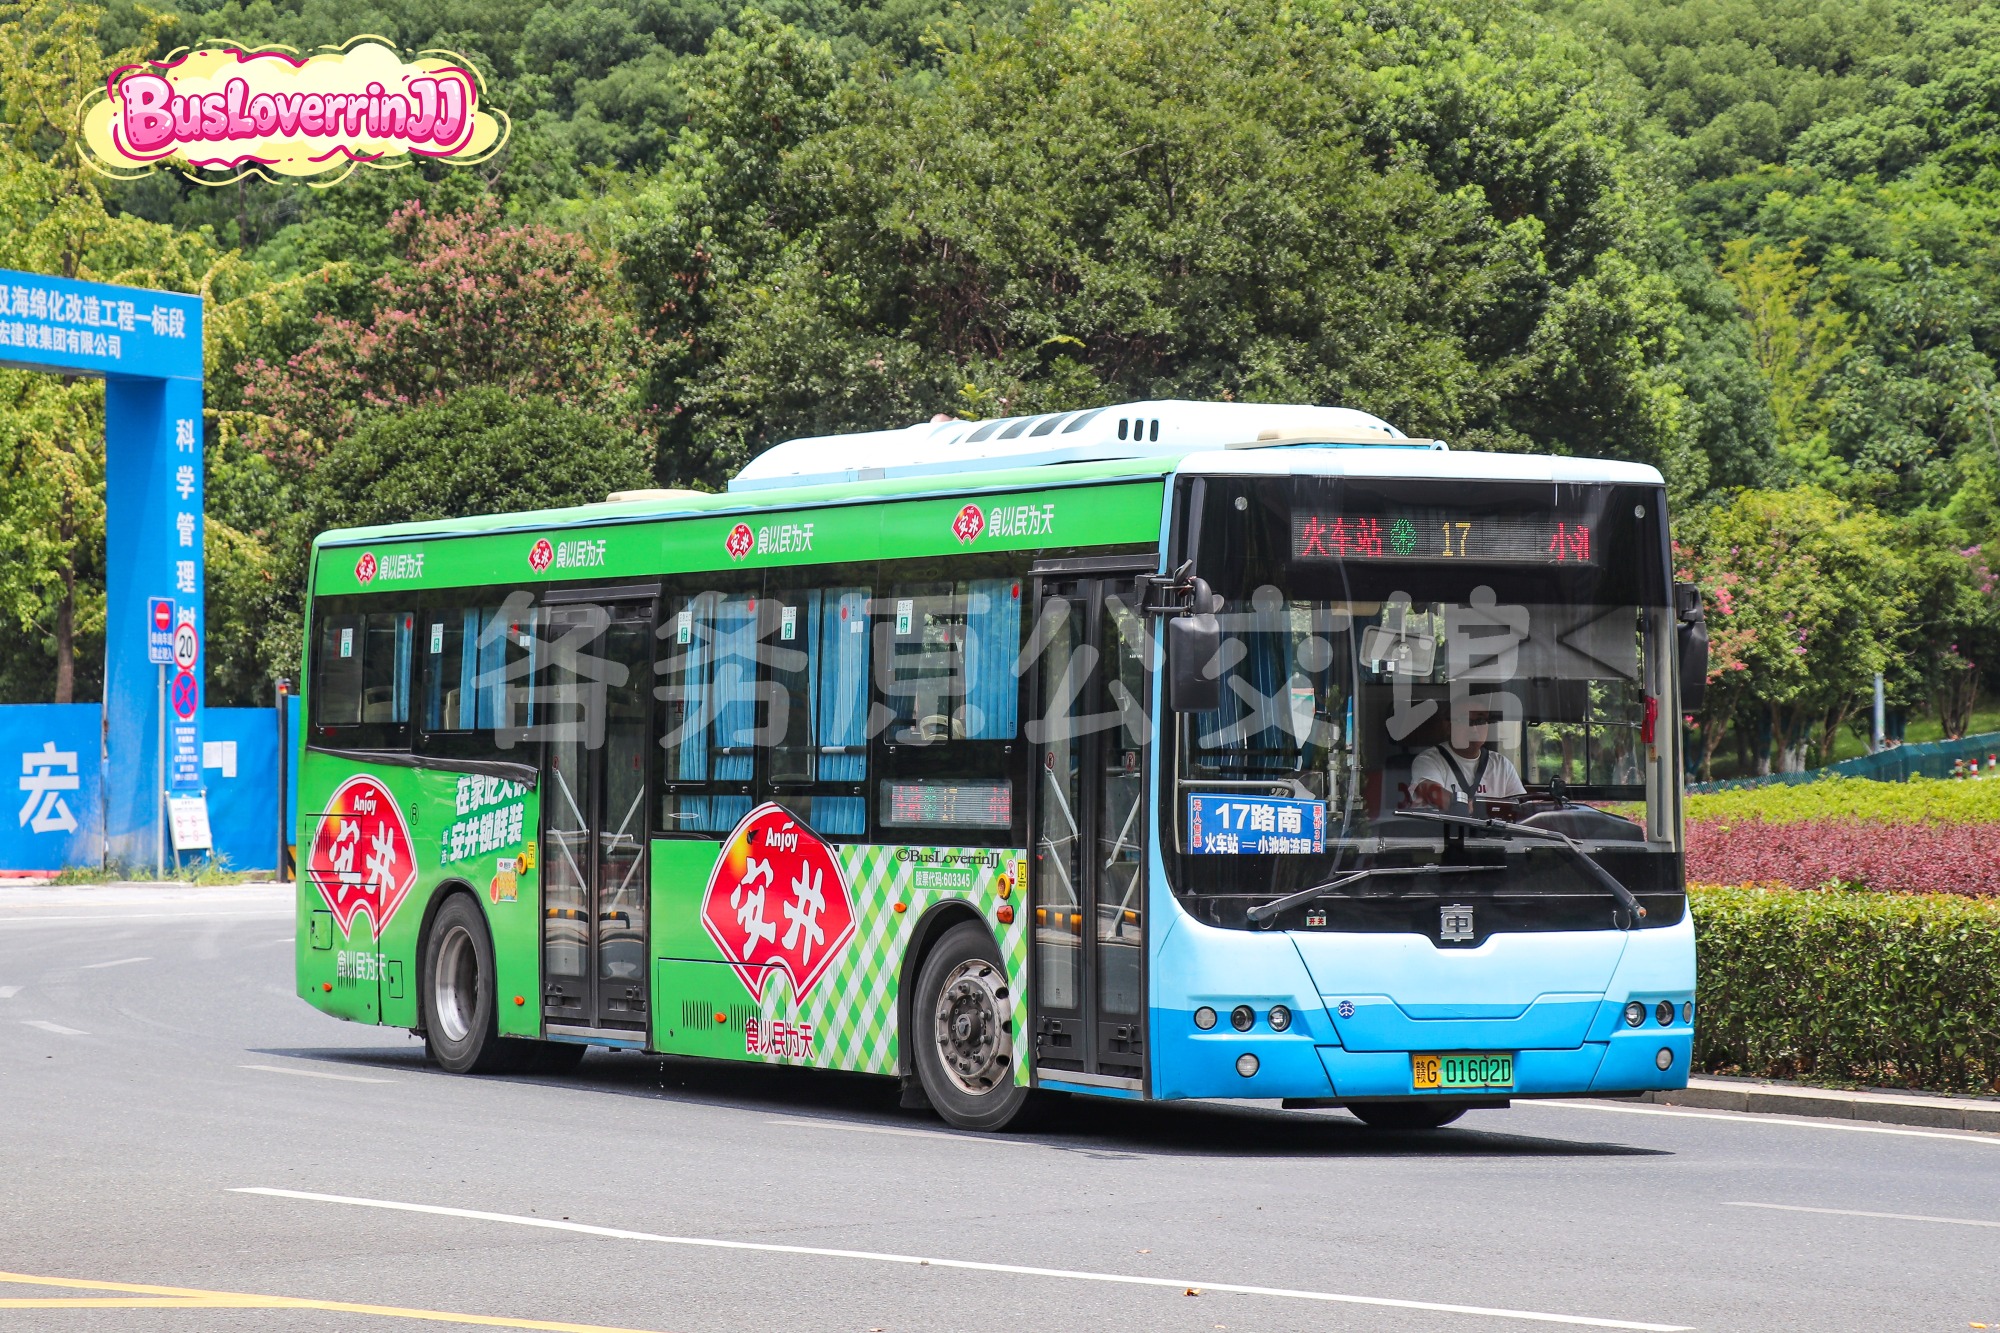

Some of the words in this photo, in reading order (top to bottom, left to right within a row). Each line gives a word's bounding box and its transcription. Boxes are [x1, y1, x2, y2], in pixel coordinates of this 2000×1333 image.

[988, 504, 1055, 538] 食以民为天
[1301, 516, 1382, 557] 火车站
[1442, 522, 1471, 557] 17
[556, 539, 606, 568] 食以民为天
[757, 523, 814, 554] 食以民为天
[379, 553, 424, 580] 食以民为天
[179, 635, 193, 658] 20
[19, 741, 80, 834] 宏
[354, 789, 377, 816] Anjoy
[449, 802, 525, 862] 安井锁鲜装
[1215, 802, 1302, 834] 17路南
[1313, 805, 1322, 853] 票价3元
[765, 821, 798, 852] Anjoy
[1204, 832, 1239, 855] 火车站
[1257, 835, 1312, 855] 小池物流园
[329, 819, 396, 907] 安井
[915, 869, 971, 888] 股票代码:603345
[730, 857, 826, 967] 安井
[337, 949, 387, 982] 食以民为天
[745, 1016, 815, 1060] 食以民为天
[1446, 1058, 1512, 1083] 01602D
